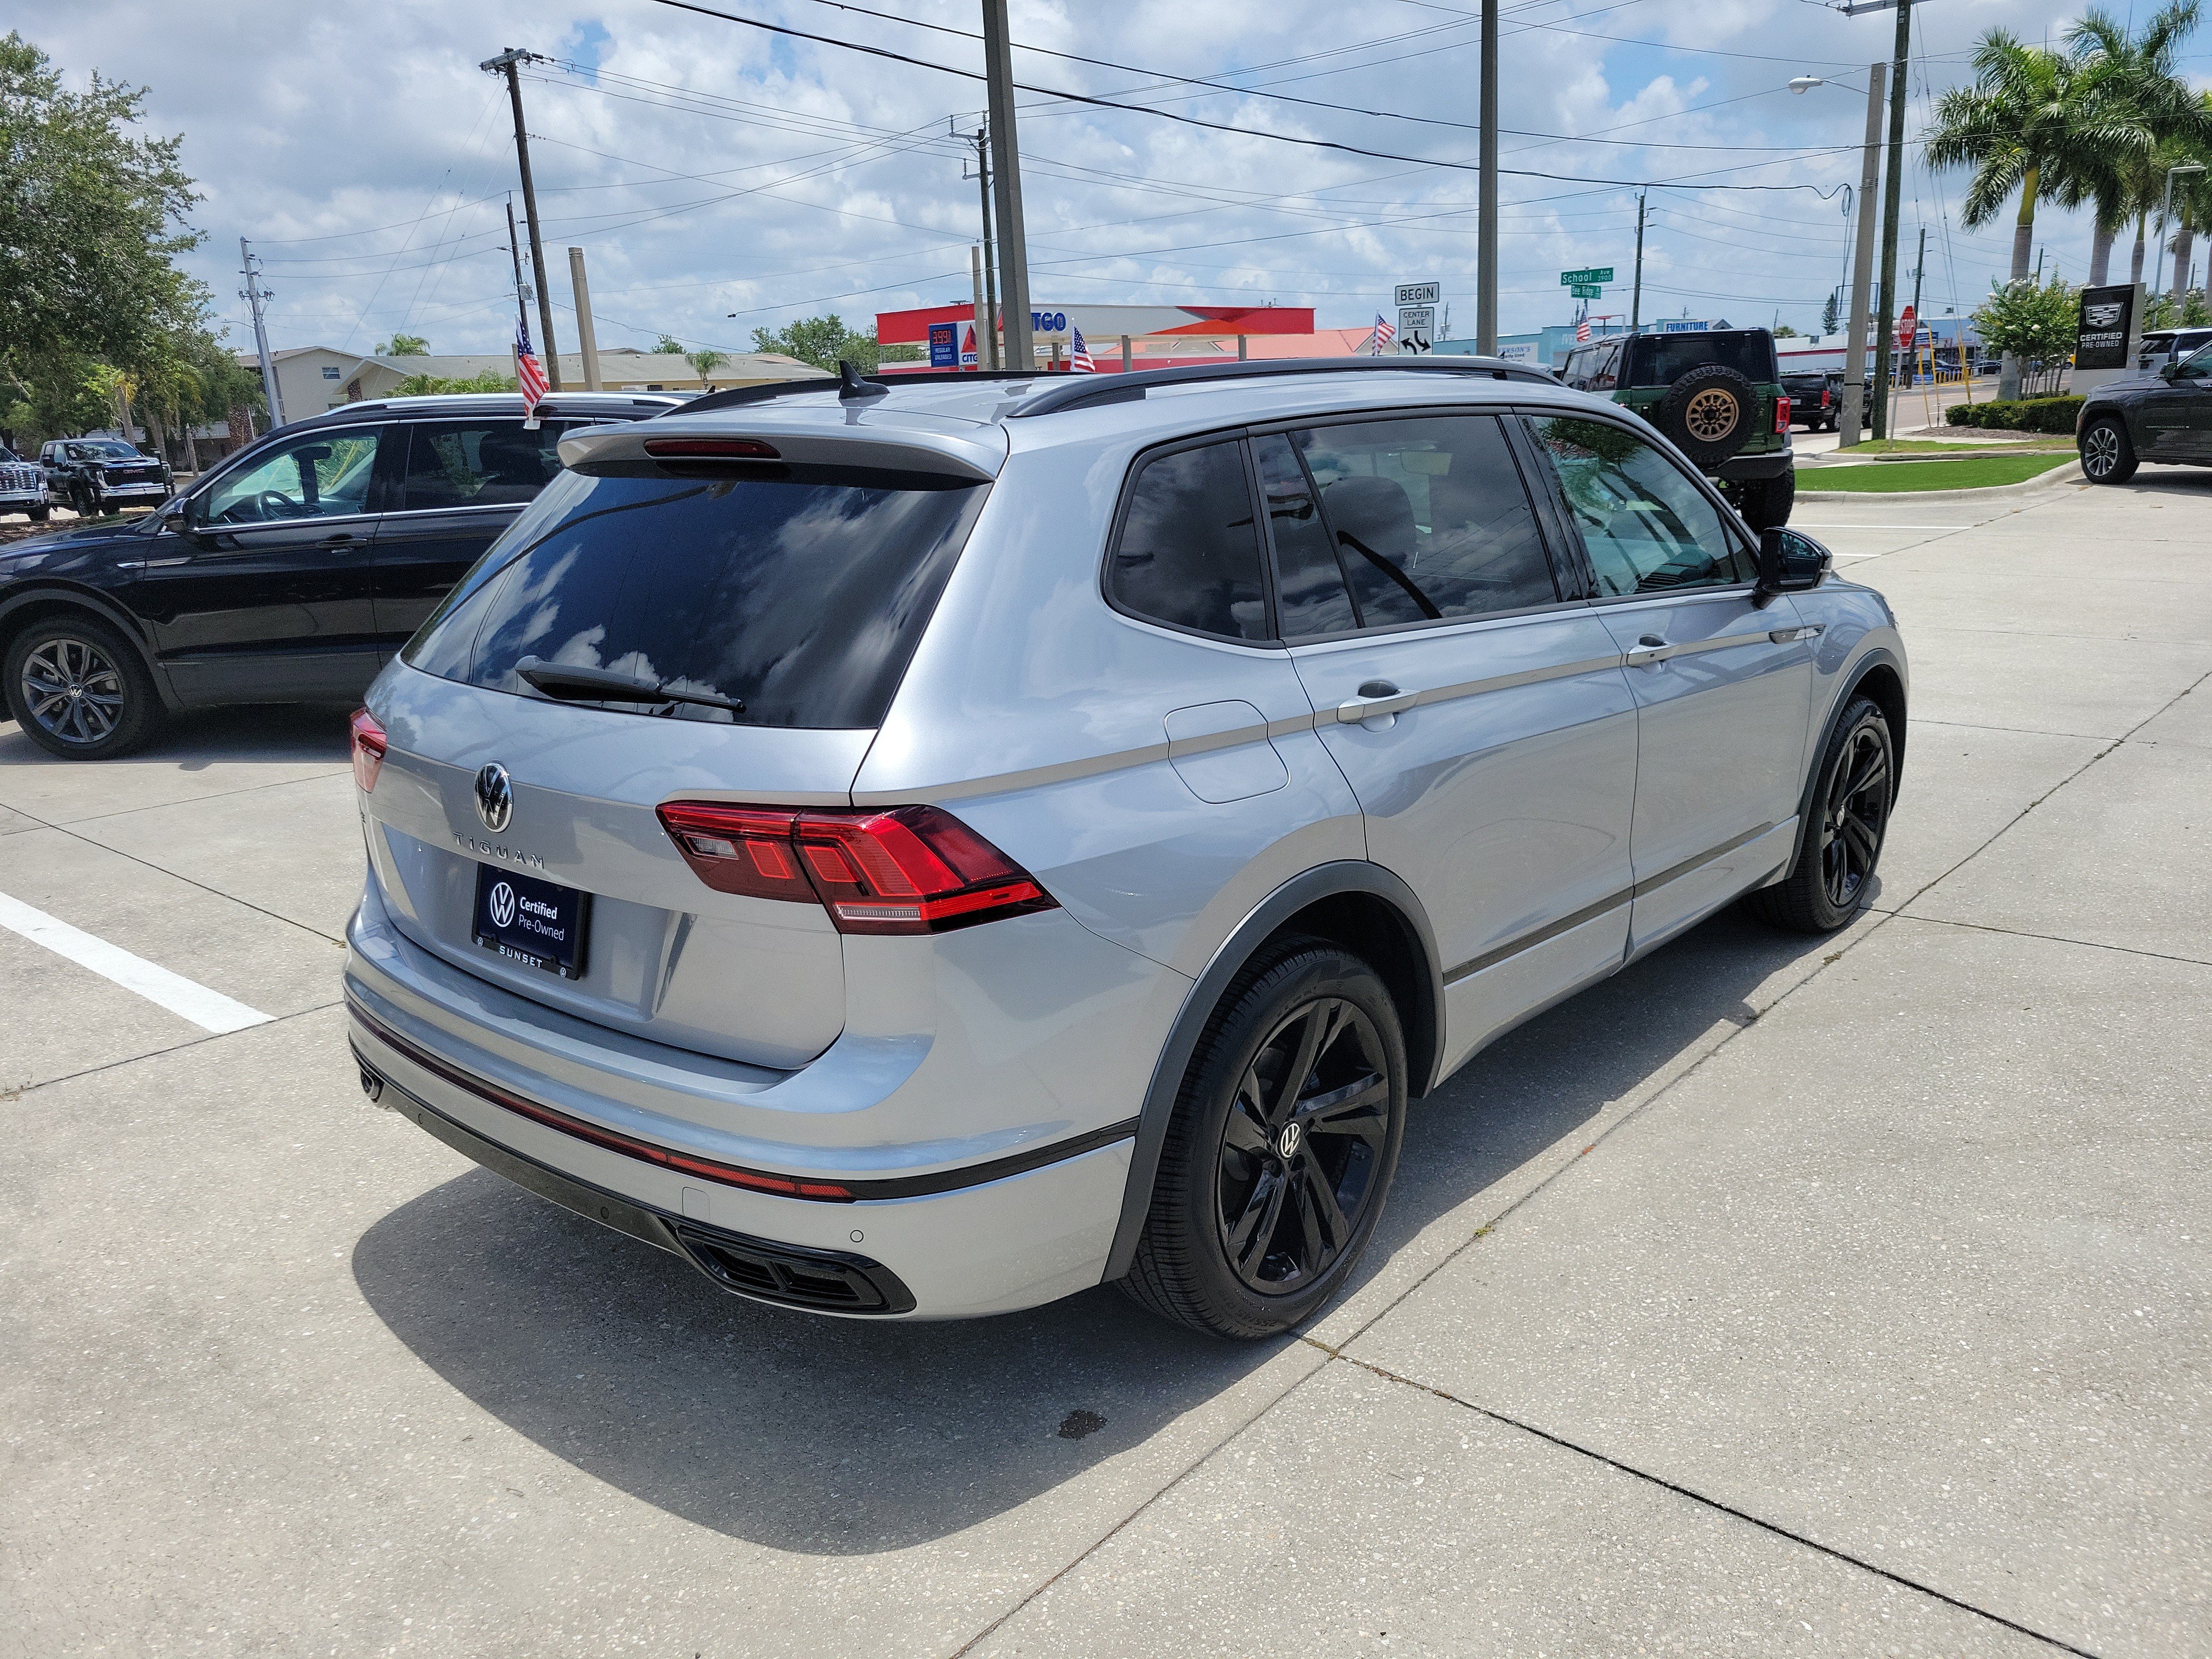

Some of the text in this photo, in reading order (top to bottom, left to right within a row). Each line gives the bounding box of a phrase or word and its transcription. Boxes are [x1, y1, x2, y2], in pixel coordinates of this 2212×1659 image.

[1562, 272, 1592, 284] School
[1400, 287, 1434, 301] BEGIN
[1031, 312, 1066, 331] TGO
[1666, 321, 1708, 332] FURNITURE
[1899, 319, 1915, 334] STOP
[2080, 332, 2123, 342] CERTIFIED
[2081, 340, 2119, 348] PRE-OWNED
[962, 354, 978, 363] CITG
[453, 831, 545, 870] TIGUAN
[520, 896, 557, 920] Certified
[518, 914, 565, 941] Pre-Owned
[499, 945, 543, 969] SUNSET
